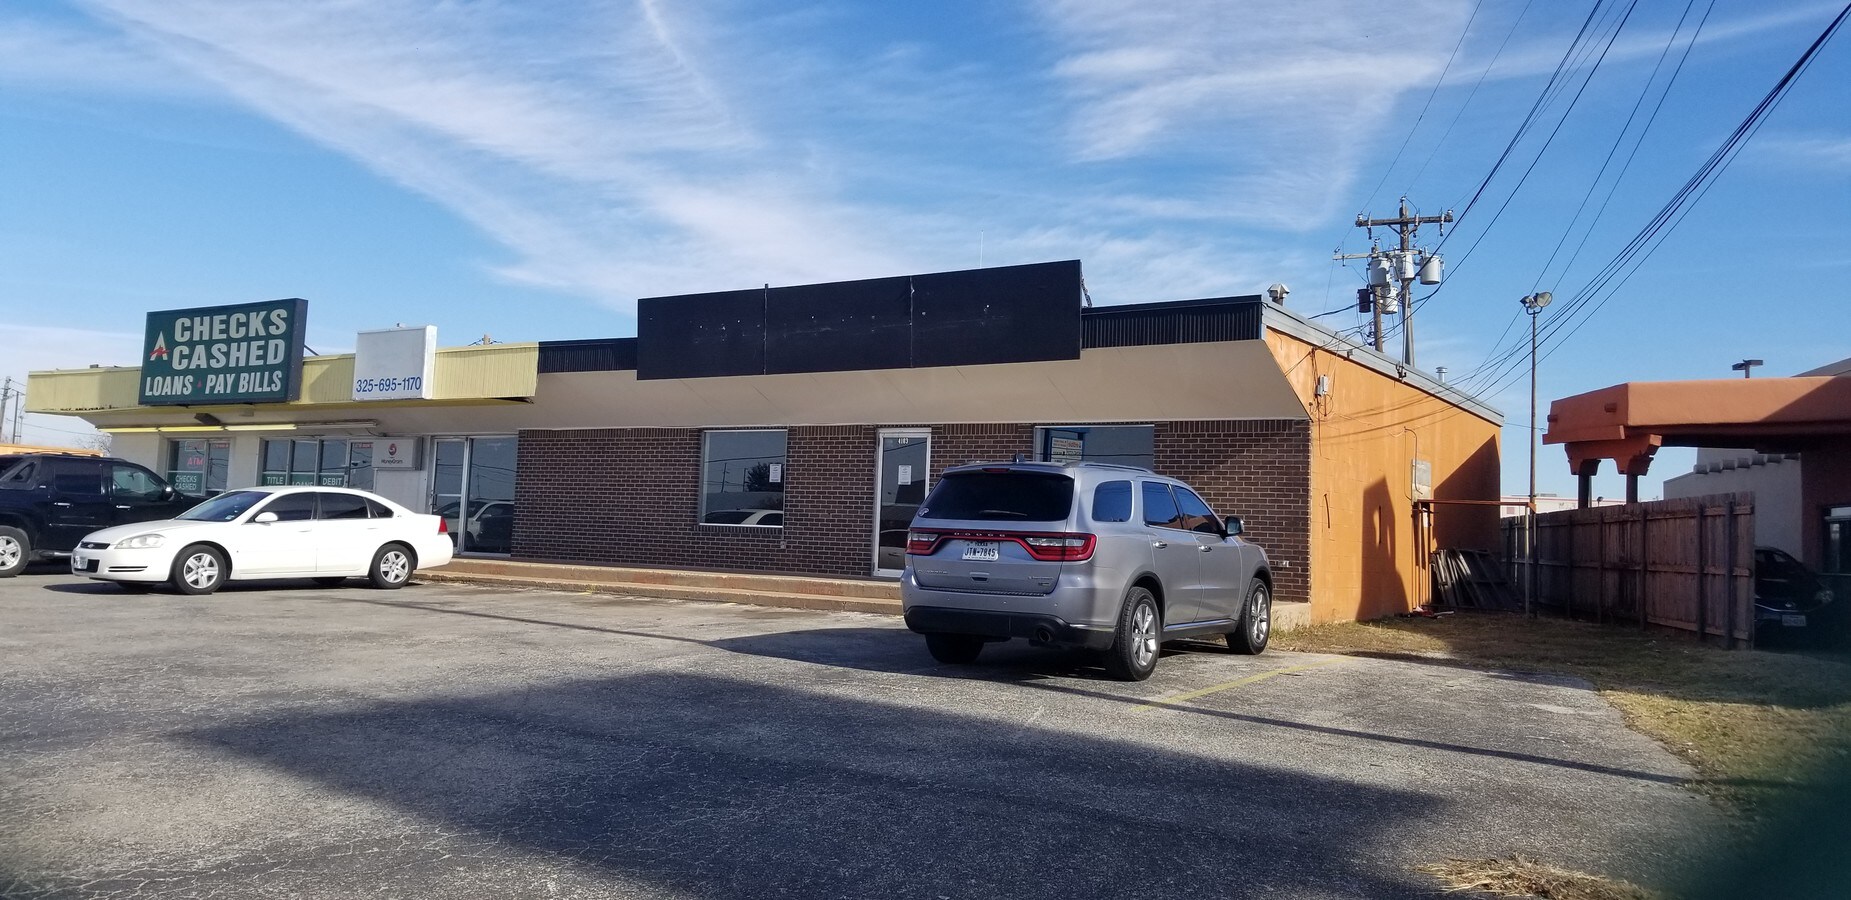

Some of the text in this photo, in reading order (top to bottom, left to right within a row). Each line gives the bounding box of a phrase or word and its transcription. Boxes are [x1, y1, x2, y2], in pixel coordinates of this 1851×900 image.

[174, 309, 287, 342] CHECKS
[172, 339, 285, 370] CASHED
[145, 375, 193, 396] LOANS
[205, 370, 282, 394] PAY BILLS
[356, 376, 422, 392] 325-695-1170
[267, 476, 284, 485] TITLE
[322, 477, 343, 486] DEBIT
